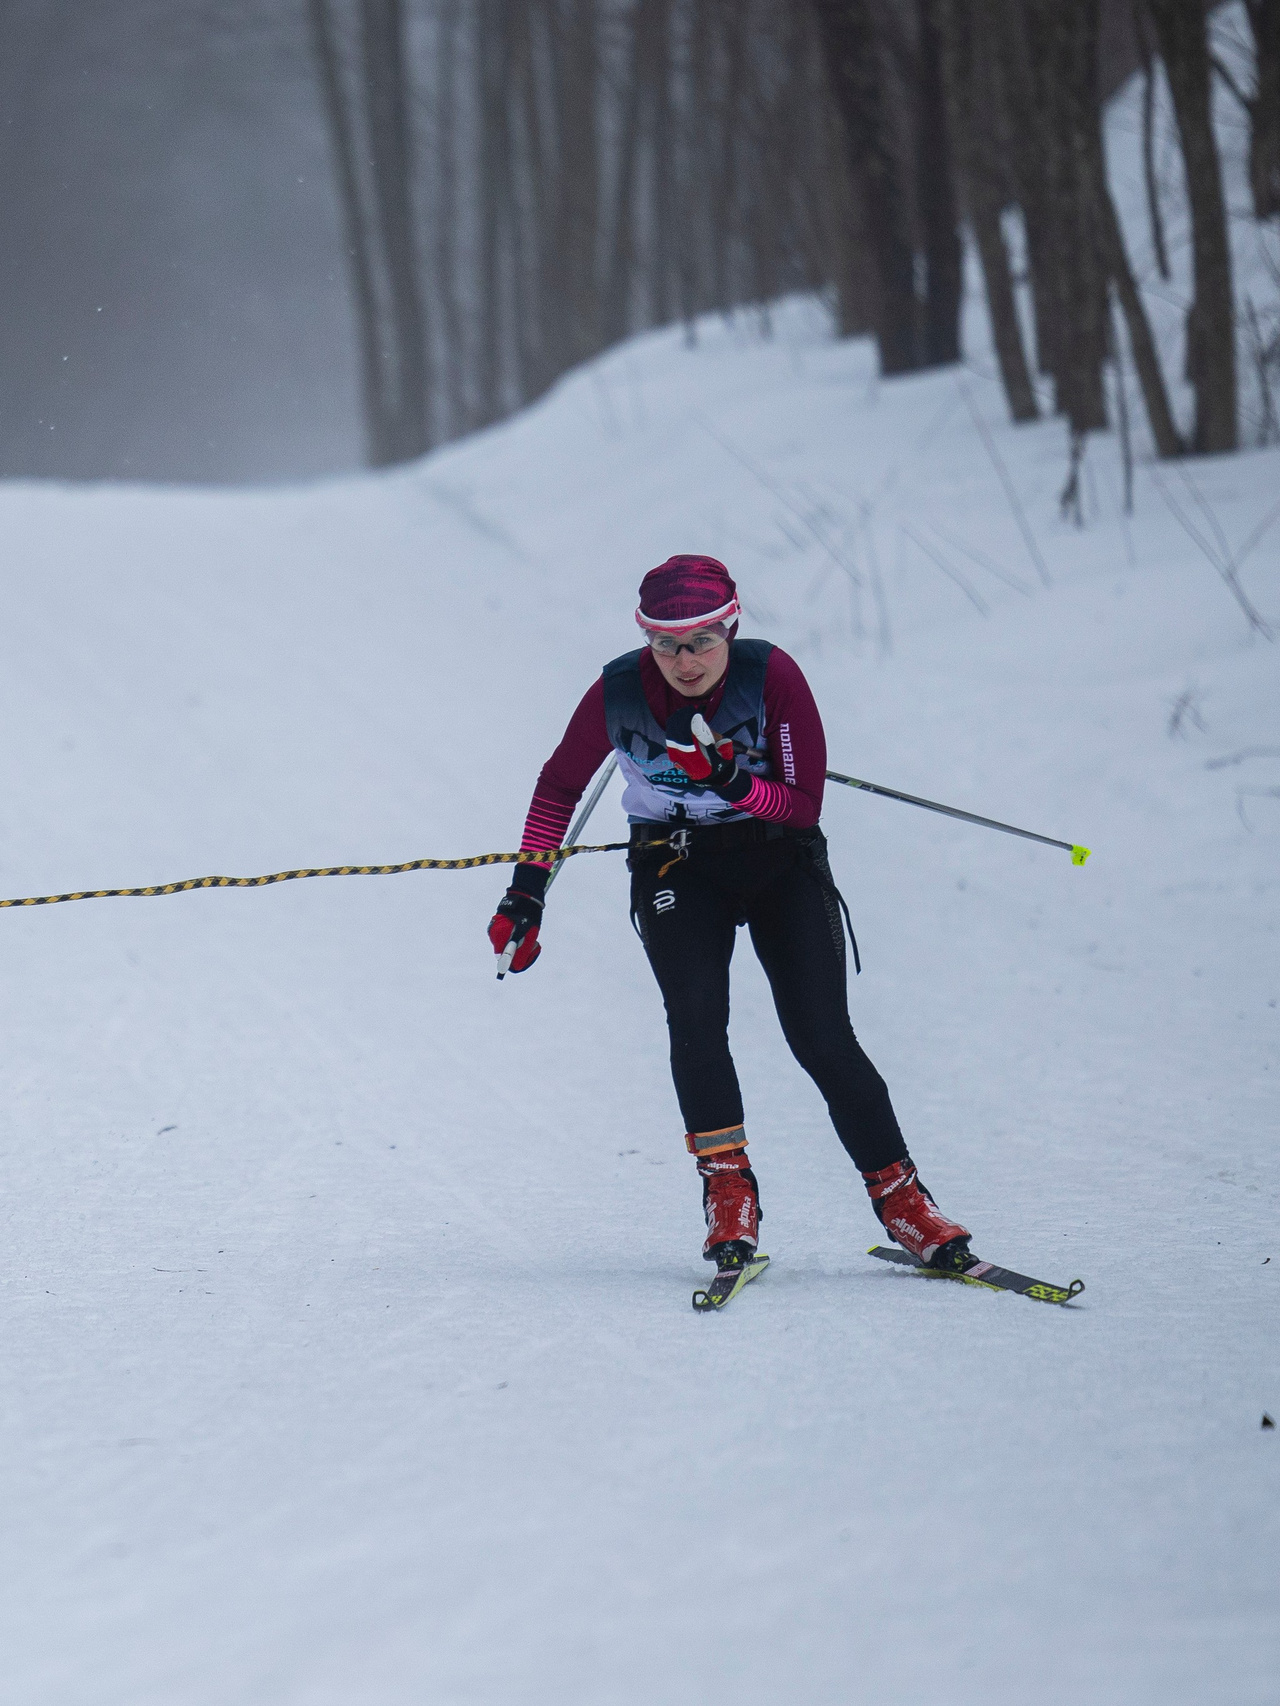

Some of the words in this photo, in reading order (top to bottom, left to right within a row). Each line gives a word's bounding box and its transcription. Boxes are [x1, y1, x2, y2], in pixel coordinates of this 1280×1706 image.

[780, 723, 796, 785] noname
[707, 1161, 739, 1170] alpina
[880, 1174, 907, 1197] alpina
[738, 1196, 751, 1228] alpina
[890, 1217, 925, 1243] alpina
